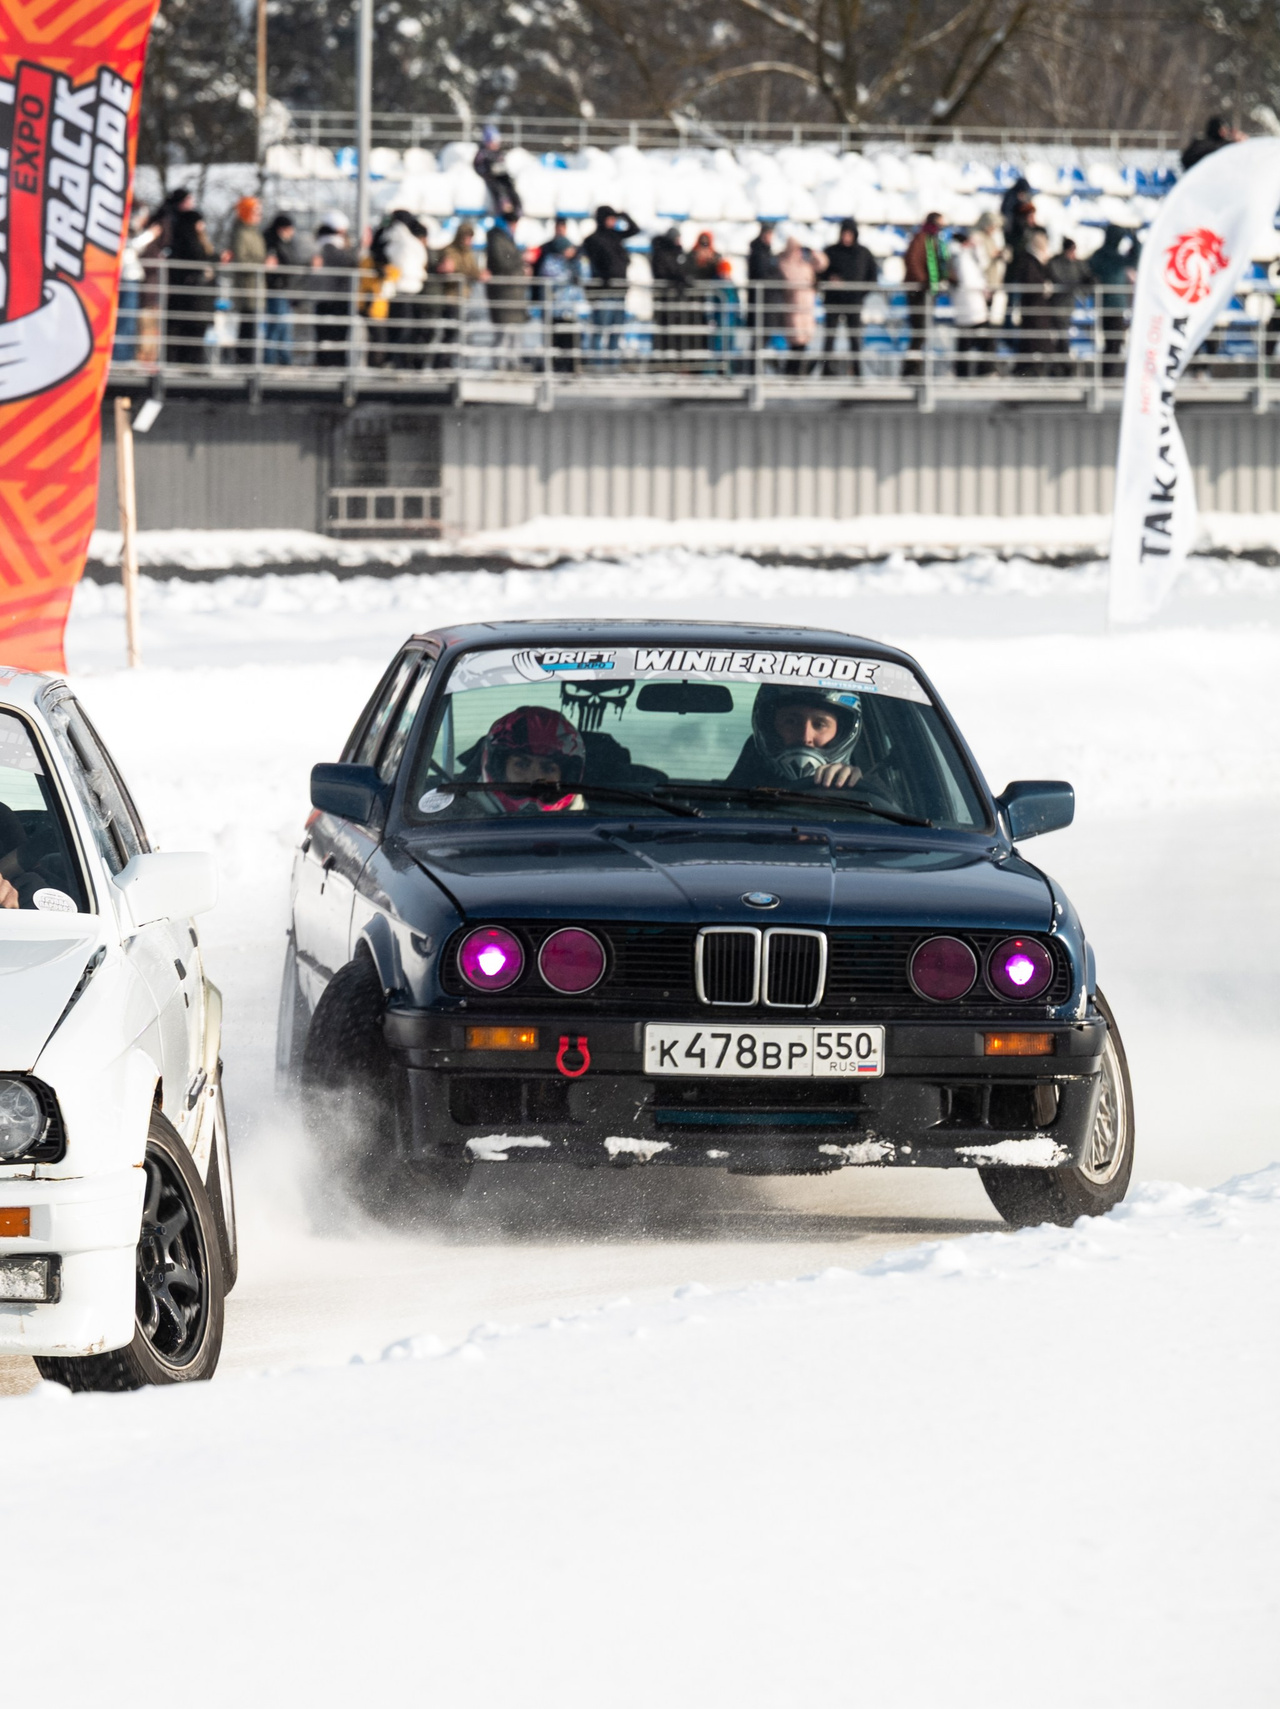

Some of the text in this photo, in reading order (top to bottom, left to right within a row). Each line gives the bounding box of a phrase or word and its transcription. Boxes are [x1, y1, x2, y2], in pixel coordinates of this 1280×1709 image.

[15, 94, 45, 195] EXPO
[42, 74, 98, 279] TRACK
[86, 69, 134, 257] MODE
[542, 651, 616, 665] DRIFT
[634, 650, 880, 685] WINTER MODE
[816, 1032, 872, 1060] 550
[829, 1062, 857, 1072] RUS
